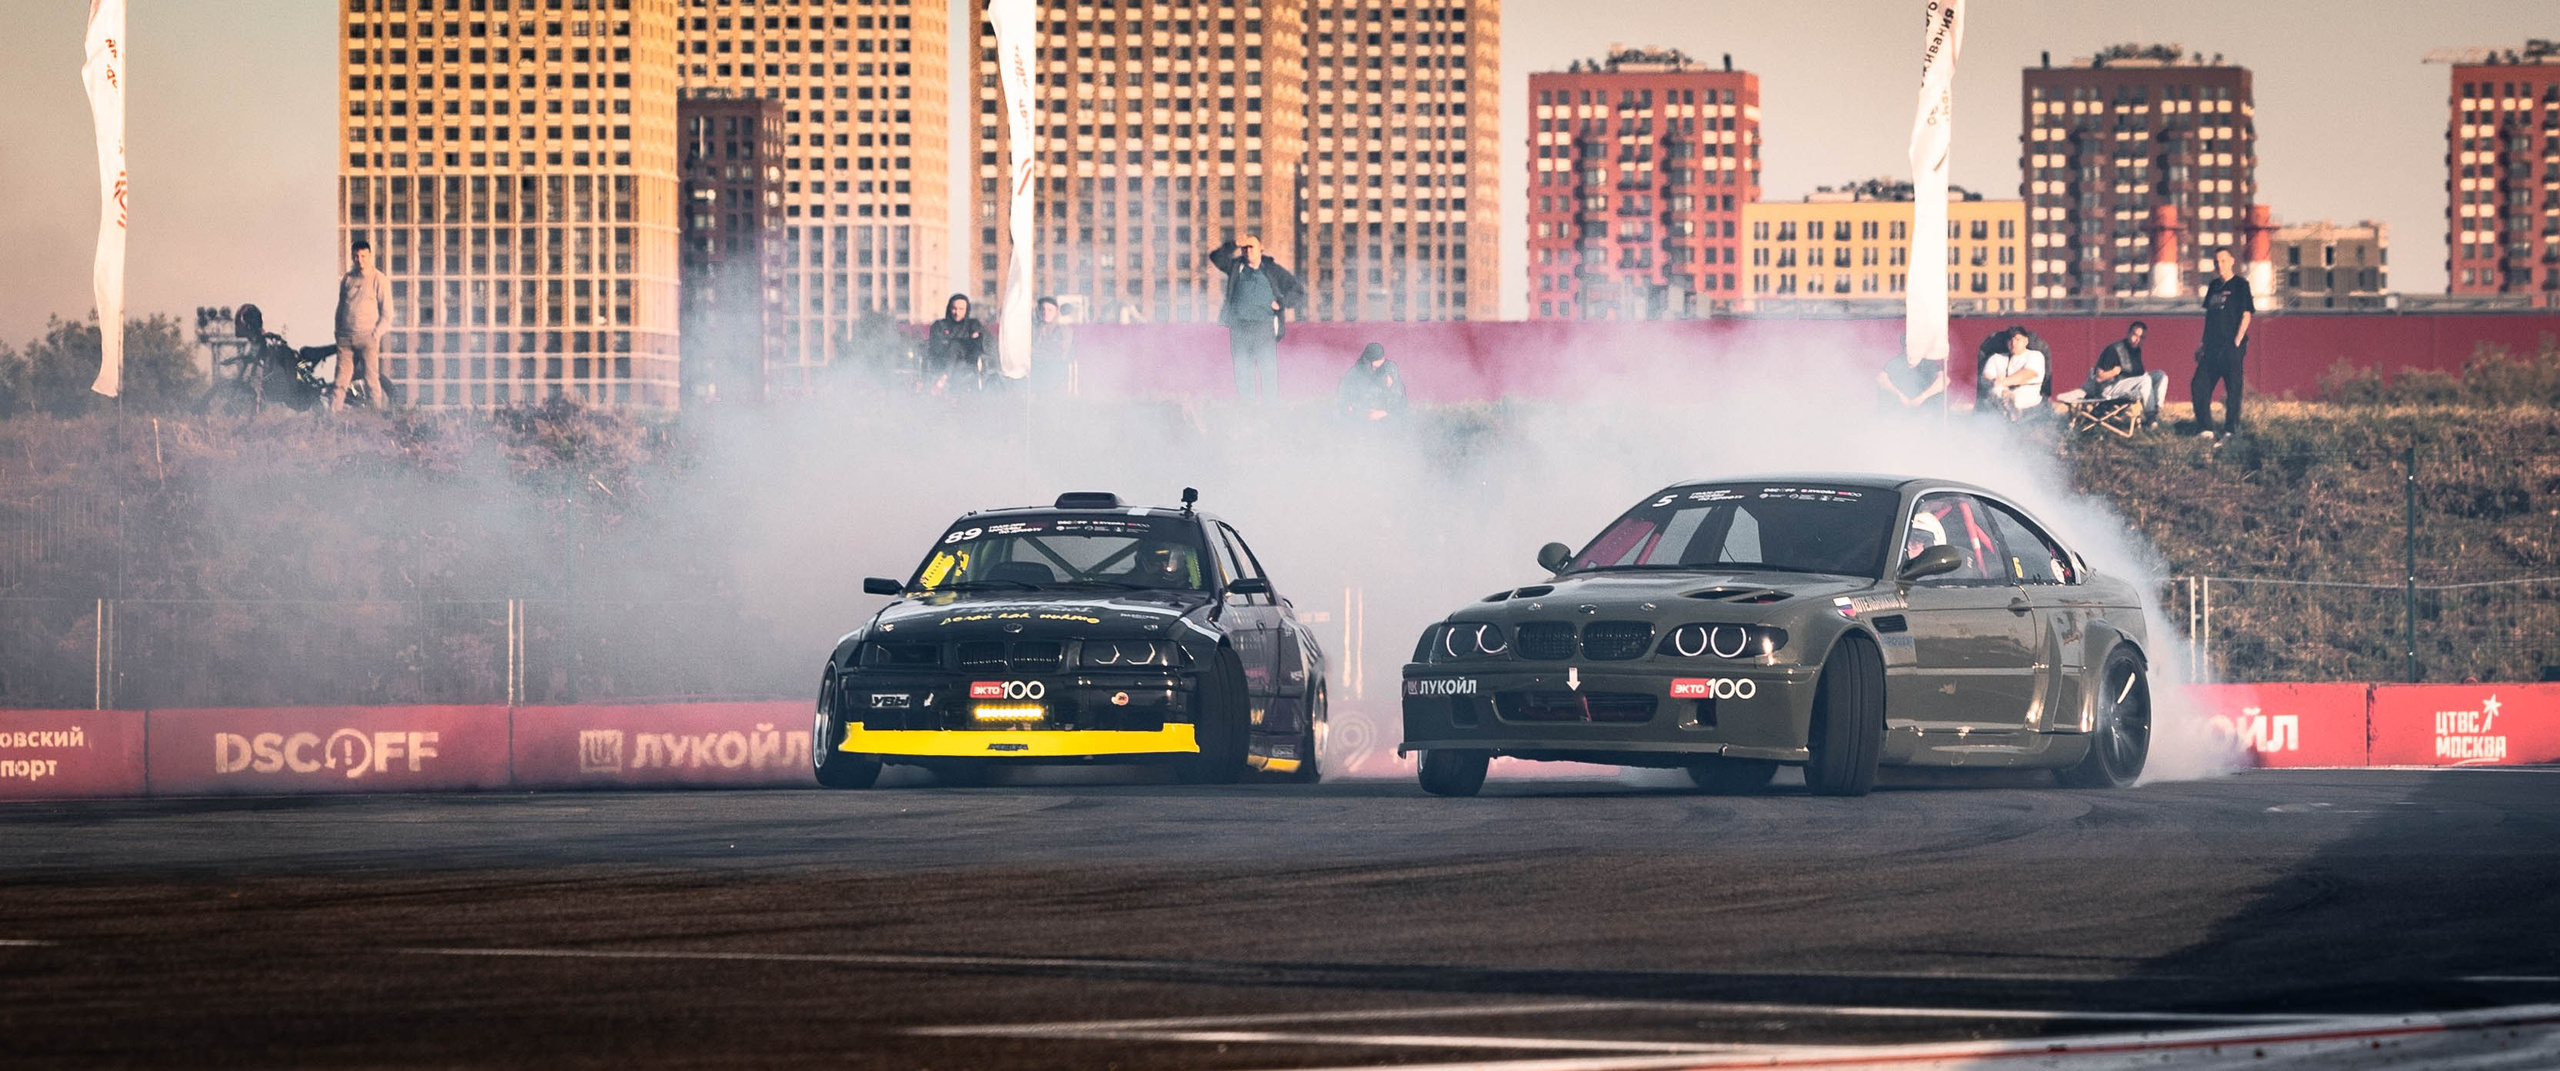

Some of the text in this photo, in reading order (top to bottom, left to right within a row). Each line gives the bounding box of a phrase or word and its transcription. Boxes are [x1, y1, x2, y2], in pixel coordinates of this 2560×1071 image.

[1652, 494, 1678, 507] 5
[944, 528, 982, 544] 89
[1419, 676, 1477, 695] ЛУКОЙЛ
[2435, 711, 2480, 736] ЦТВС
[0, 725, 84, 748] овский
[631, 723, 810, 769] ЛУКОЙЛ
[2435, 735, 2507, 758] МОСКВА
[1, 759, 58, 781] порт
